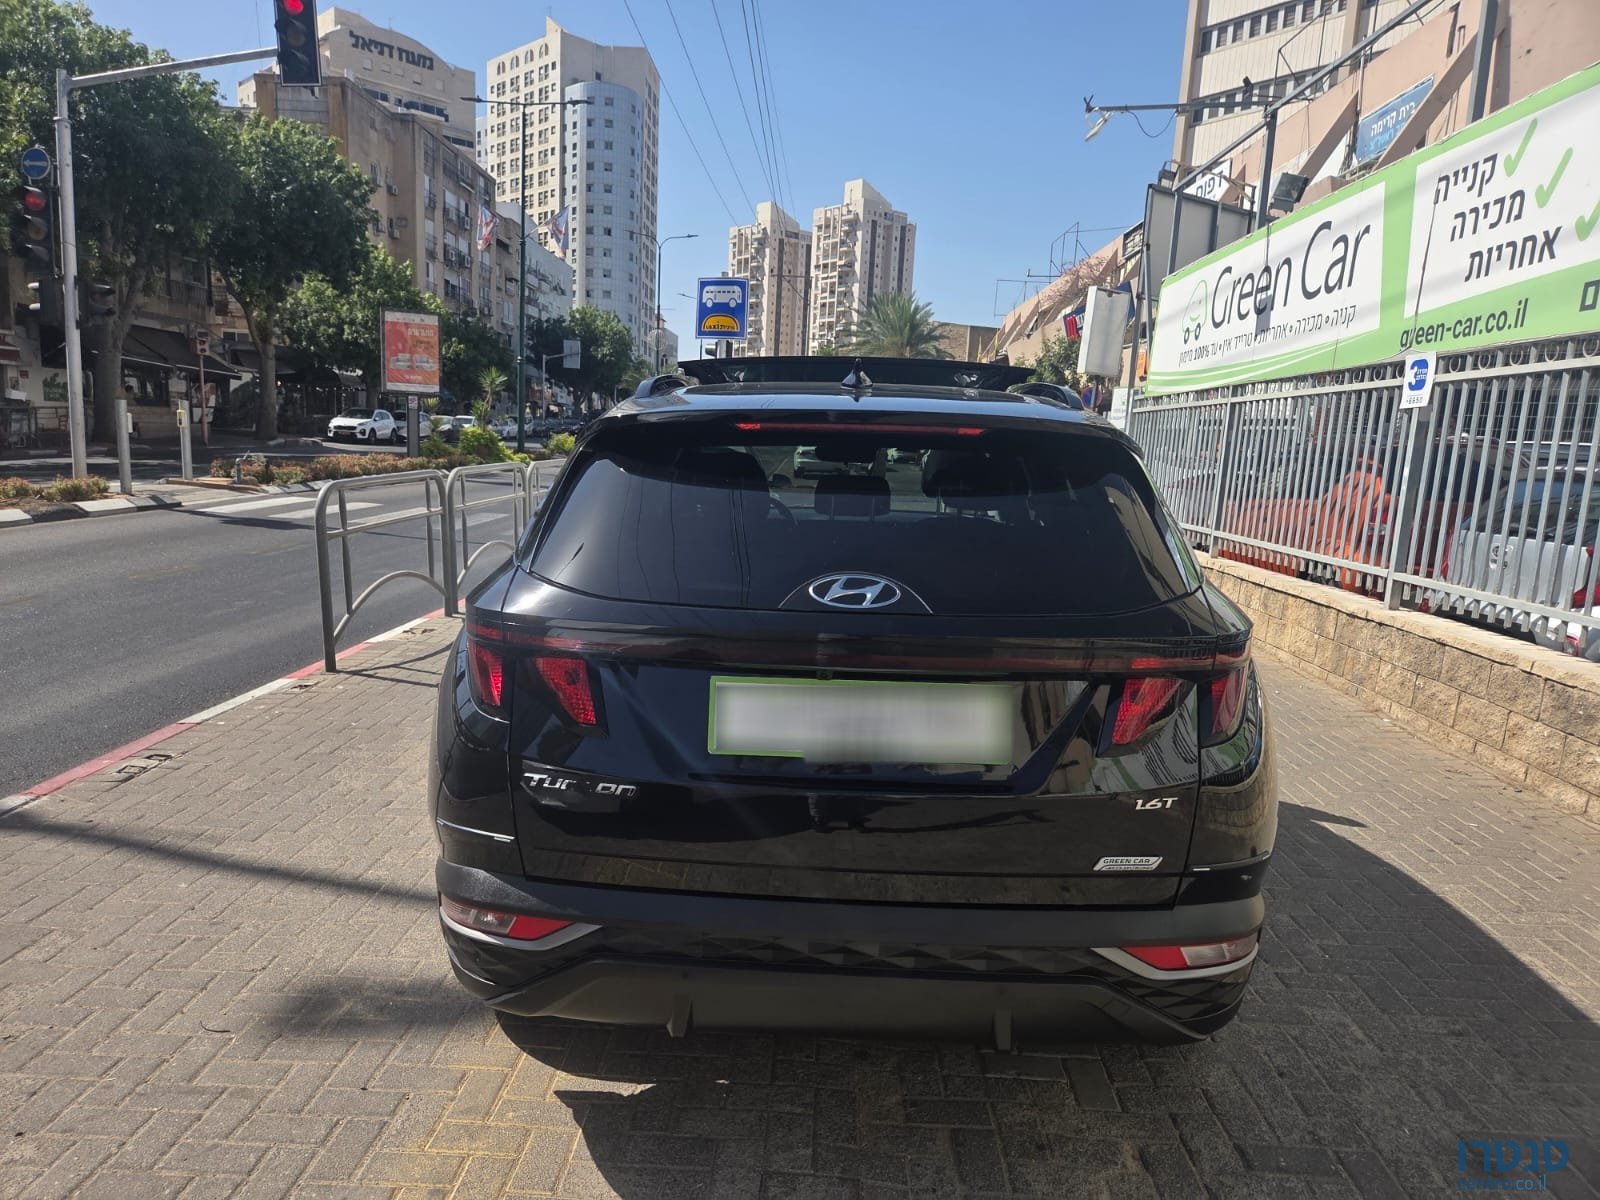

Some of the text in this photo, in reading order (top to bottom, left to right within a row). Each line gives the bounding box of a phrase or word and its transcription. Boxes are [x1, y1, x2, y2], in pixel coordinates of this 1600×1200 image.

[349, 30, 394, 58] דניאל
[1371, 111, 1397, 137] קדימה
[1433, 153, 1498, 205] קנייה
[1450, 189, 1526, 242] מכירה
[1464, 226, 1562, 282] אחריות
[1211, 221, 1371, 329] Green Car
[1294, 313, 1323, 336] מכירה
[1330, 304, 1357, 329] קניה
